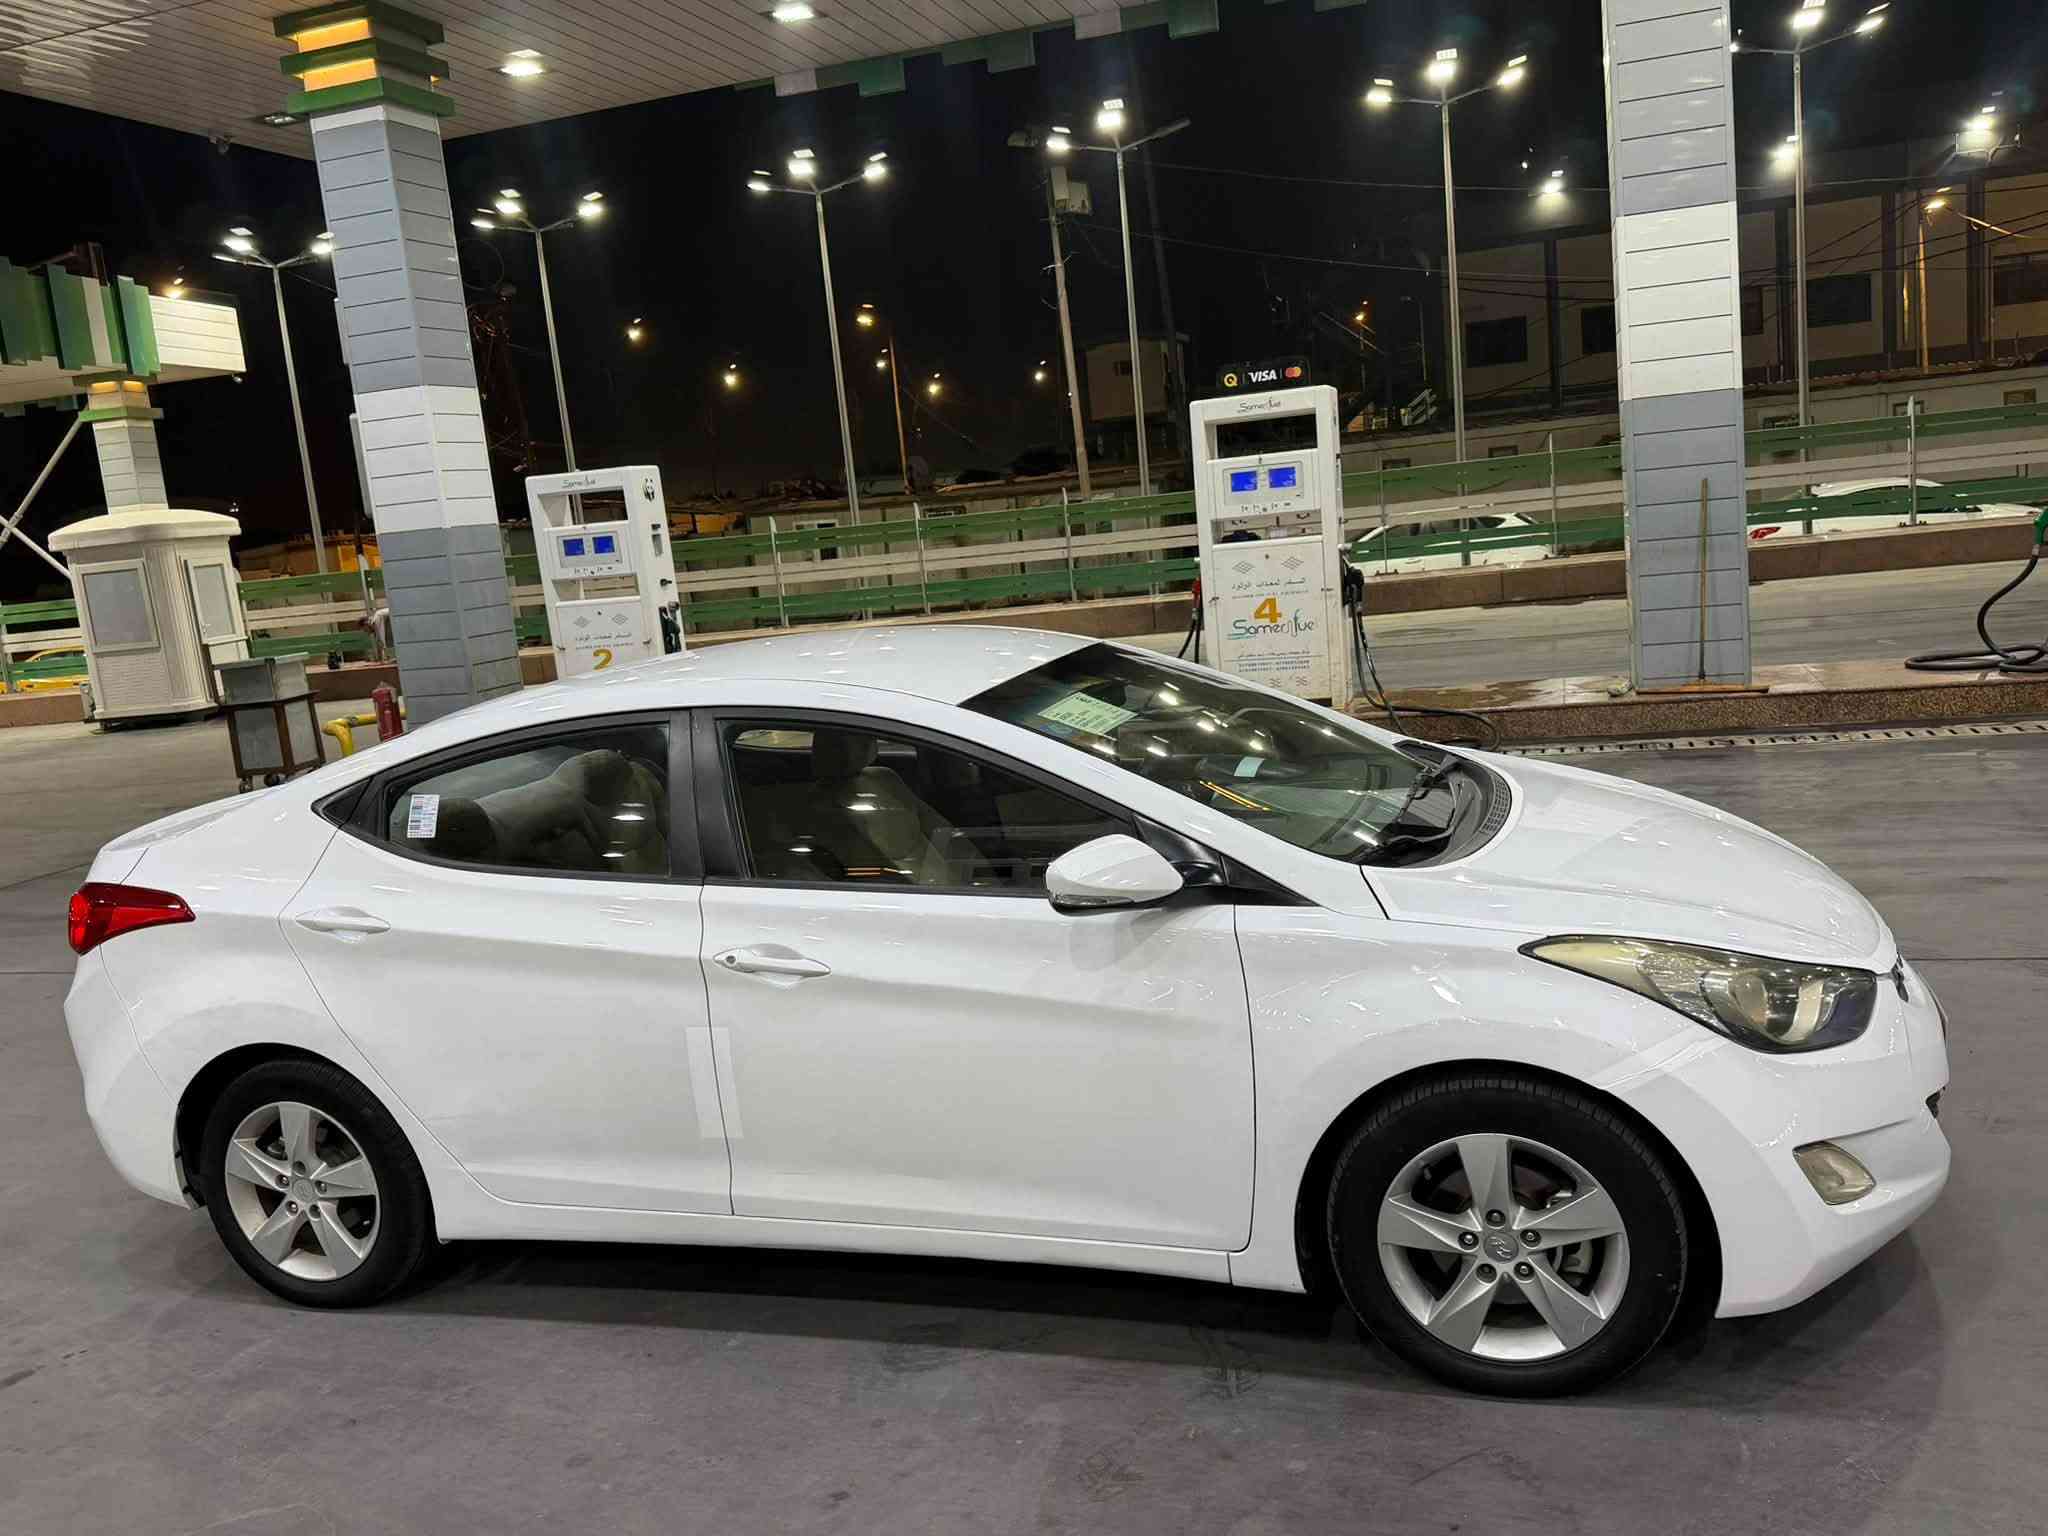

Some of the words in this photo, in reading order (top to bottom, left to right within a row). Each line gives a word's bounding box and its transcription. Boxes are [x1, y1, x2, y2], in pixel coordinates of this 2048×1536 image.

[1248, 369, 1278, 383] VISA
[1254, 596, 1282, 624] 4
[592, 649, 613, 671] 2
